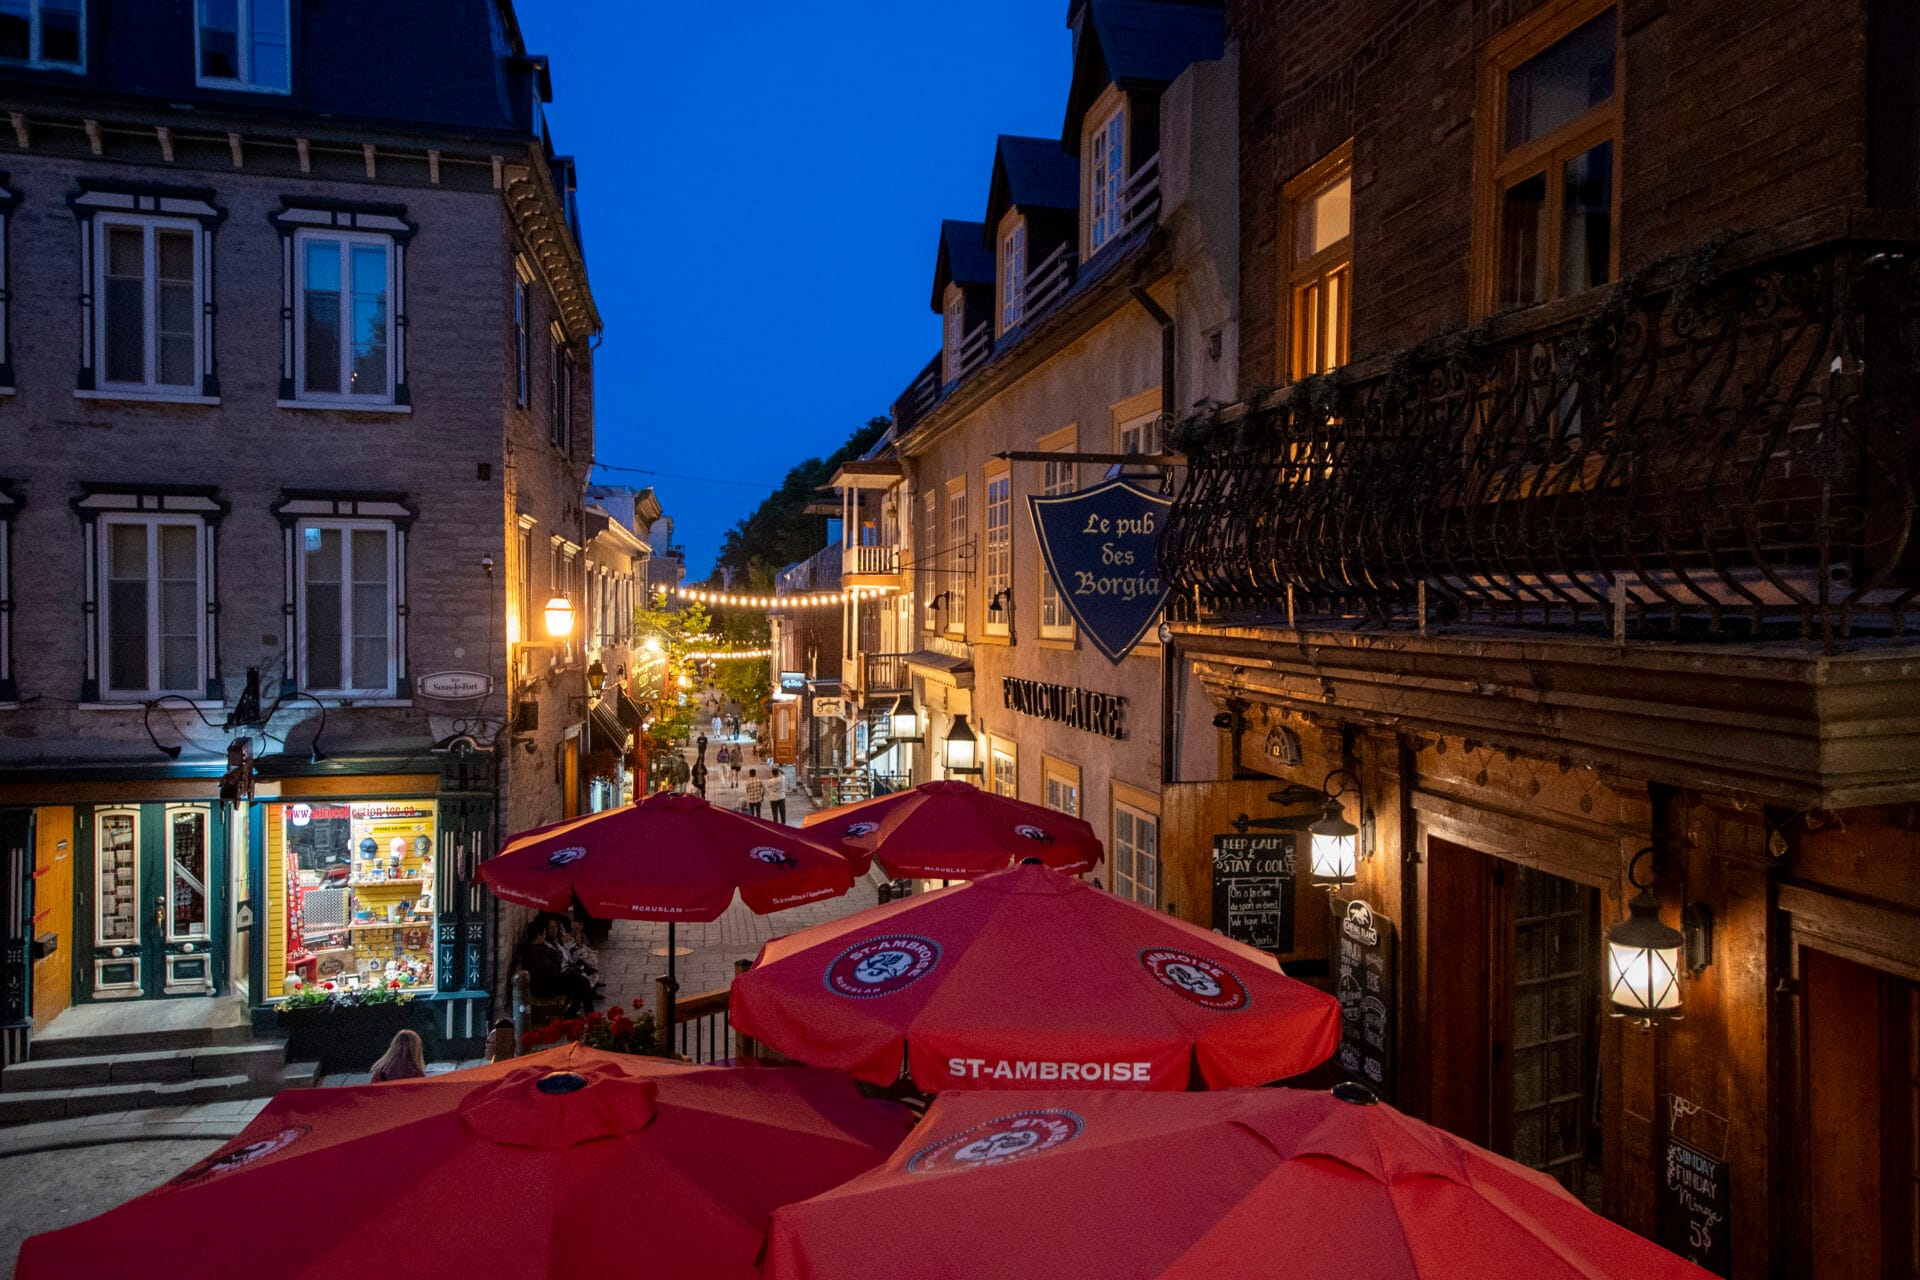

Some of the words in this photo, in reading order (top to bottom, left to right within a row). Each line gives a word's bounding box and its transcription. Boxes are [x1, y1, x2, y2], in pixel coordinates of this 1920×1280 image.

[1083, 513, 1110, 534] Le
[1116, 512, 1154, 538] pub
[1102, 543, 1134, 565] des
[433, 682, 478, 690] Sous-le-Fort
[1002, 676, 1124, 740] FUNICULAIRE
[1223, 839, 1247, 849] KEEP
[1251, 839, 1282, 849] CALM
[1222, 860, 1253, 872] STAY
[1257, 860, 1285, 872] COOL
[631, 905, 683, 913] McAUSLAN
[850, 940, 932, 977] ST-AMBROISE
[949, 1058, 1150, 1081] ST-AMBROISE
[1676, 1146, 1715, 1180] SUNDAY
[1676, 1164, 1717, 1200] FUNDAY
